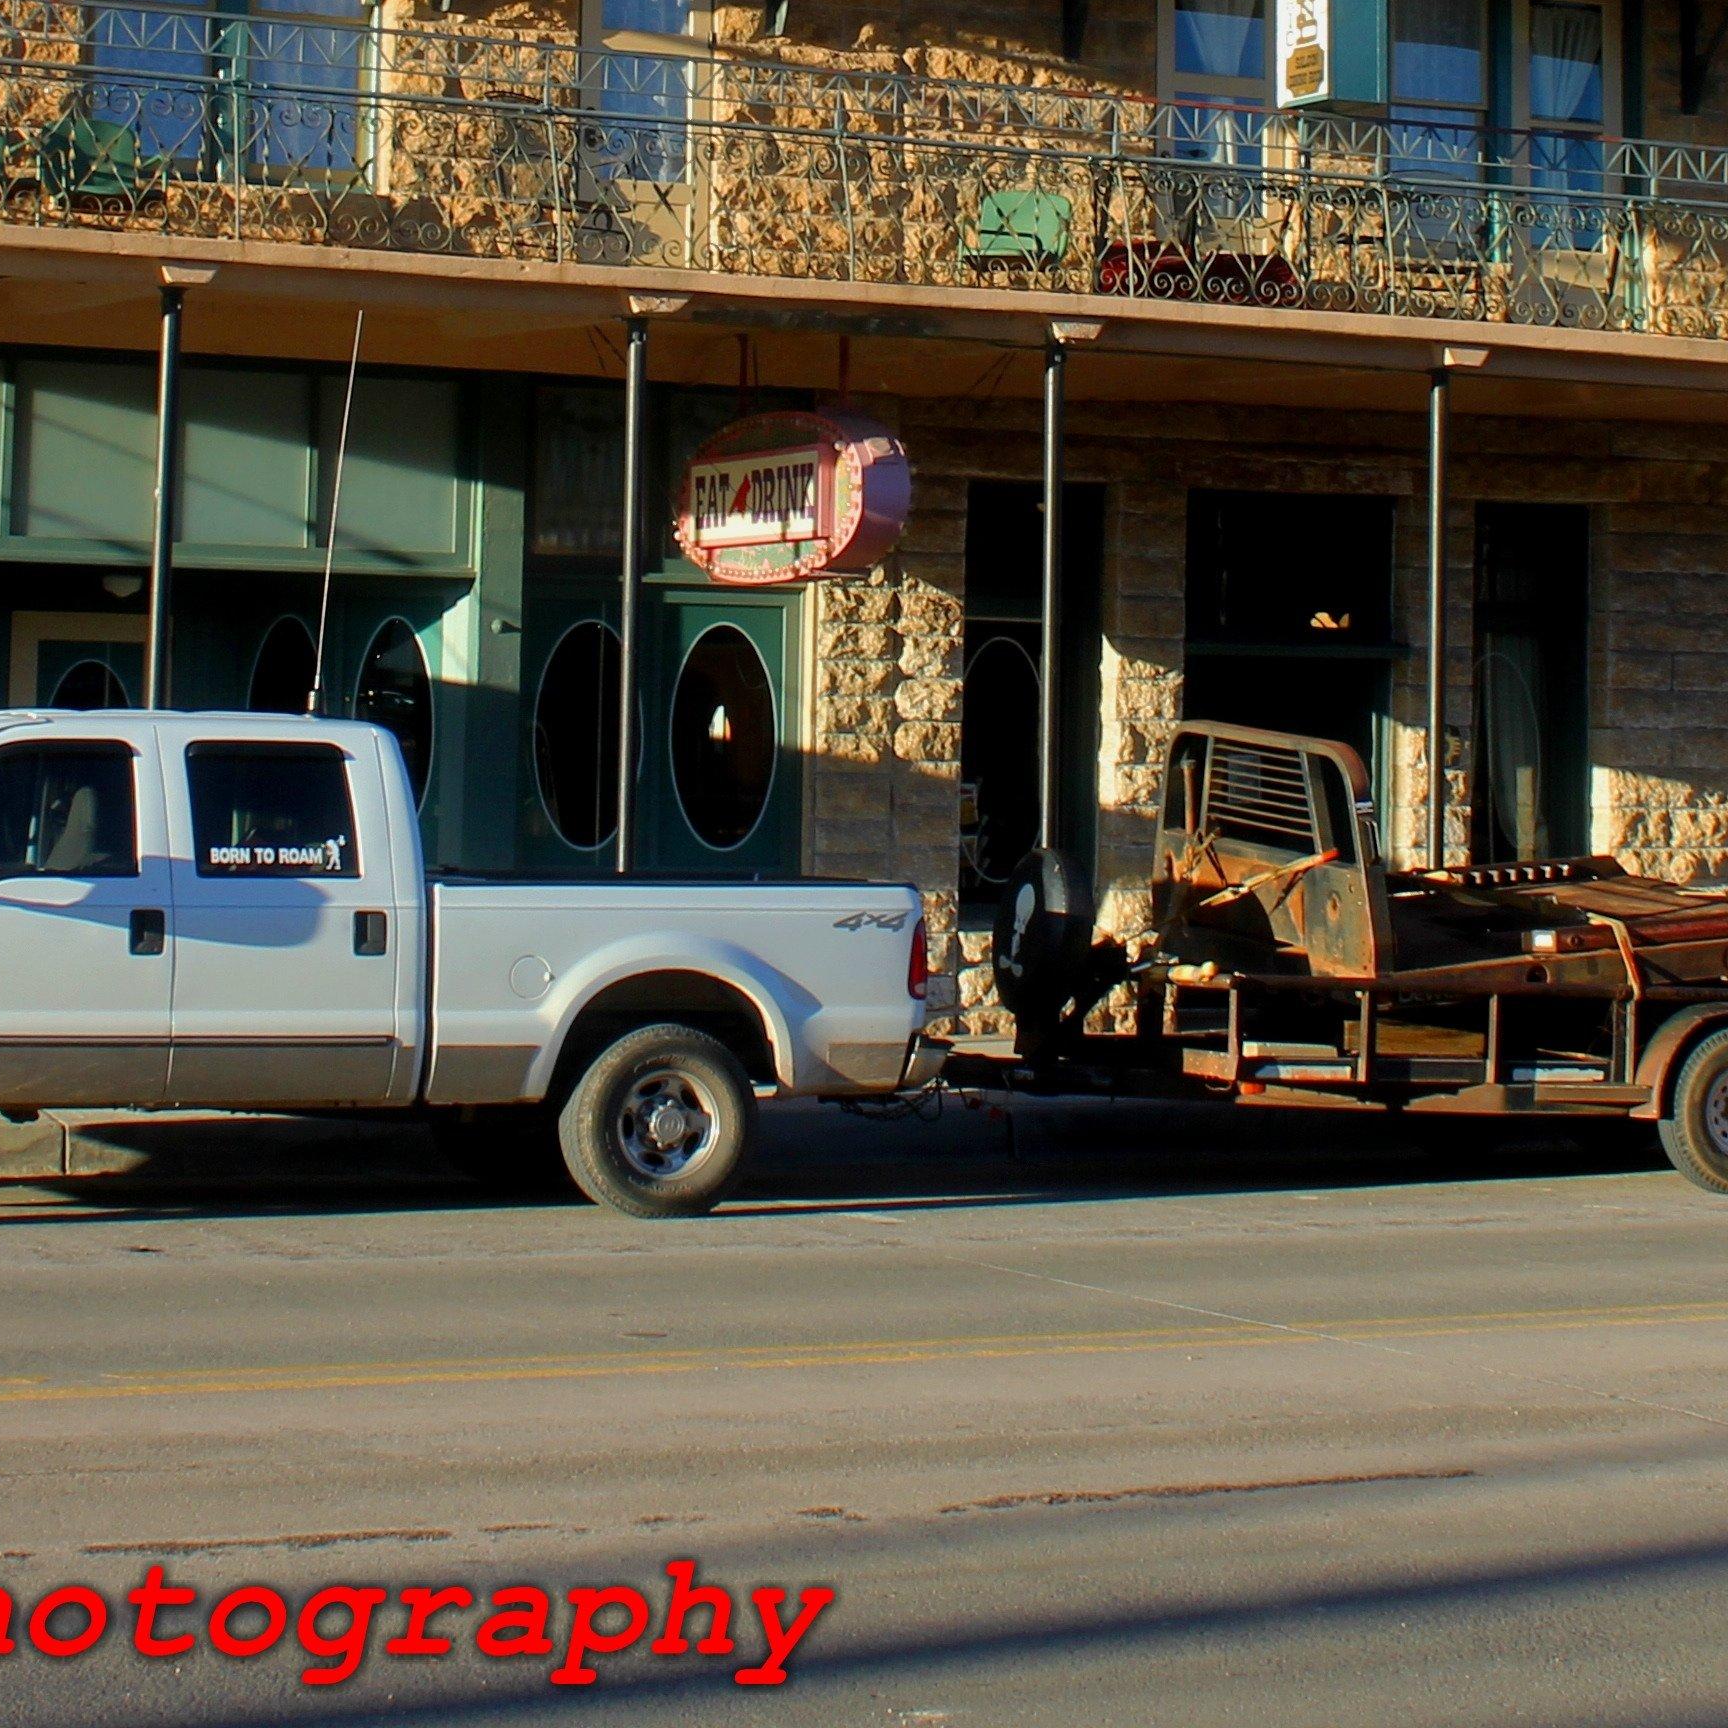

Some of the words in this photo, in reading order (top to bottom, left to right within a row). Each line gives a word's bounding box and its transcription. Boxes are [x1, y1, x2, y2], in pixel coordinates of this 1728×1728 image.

[695, 472, 730, 530] EAT
[750, 462, 815, 524] DRINK
[209, 846, 251, 865] BORN
[253, 846, 276, 865] TO
[278, 846, 323, 865] ROAM
